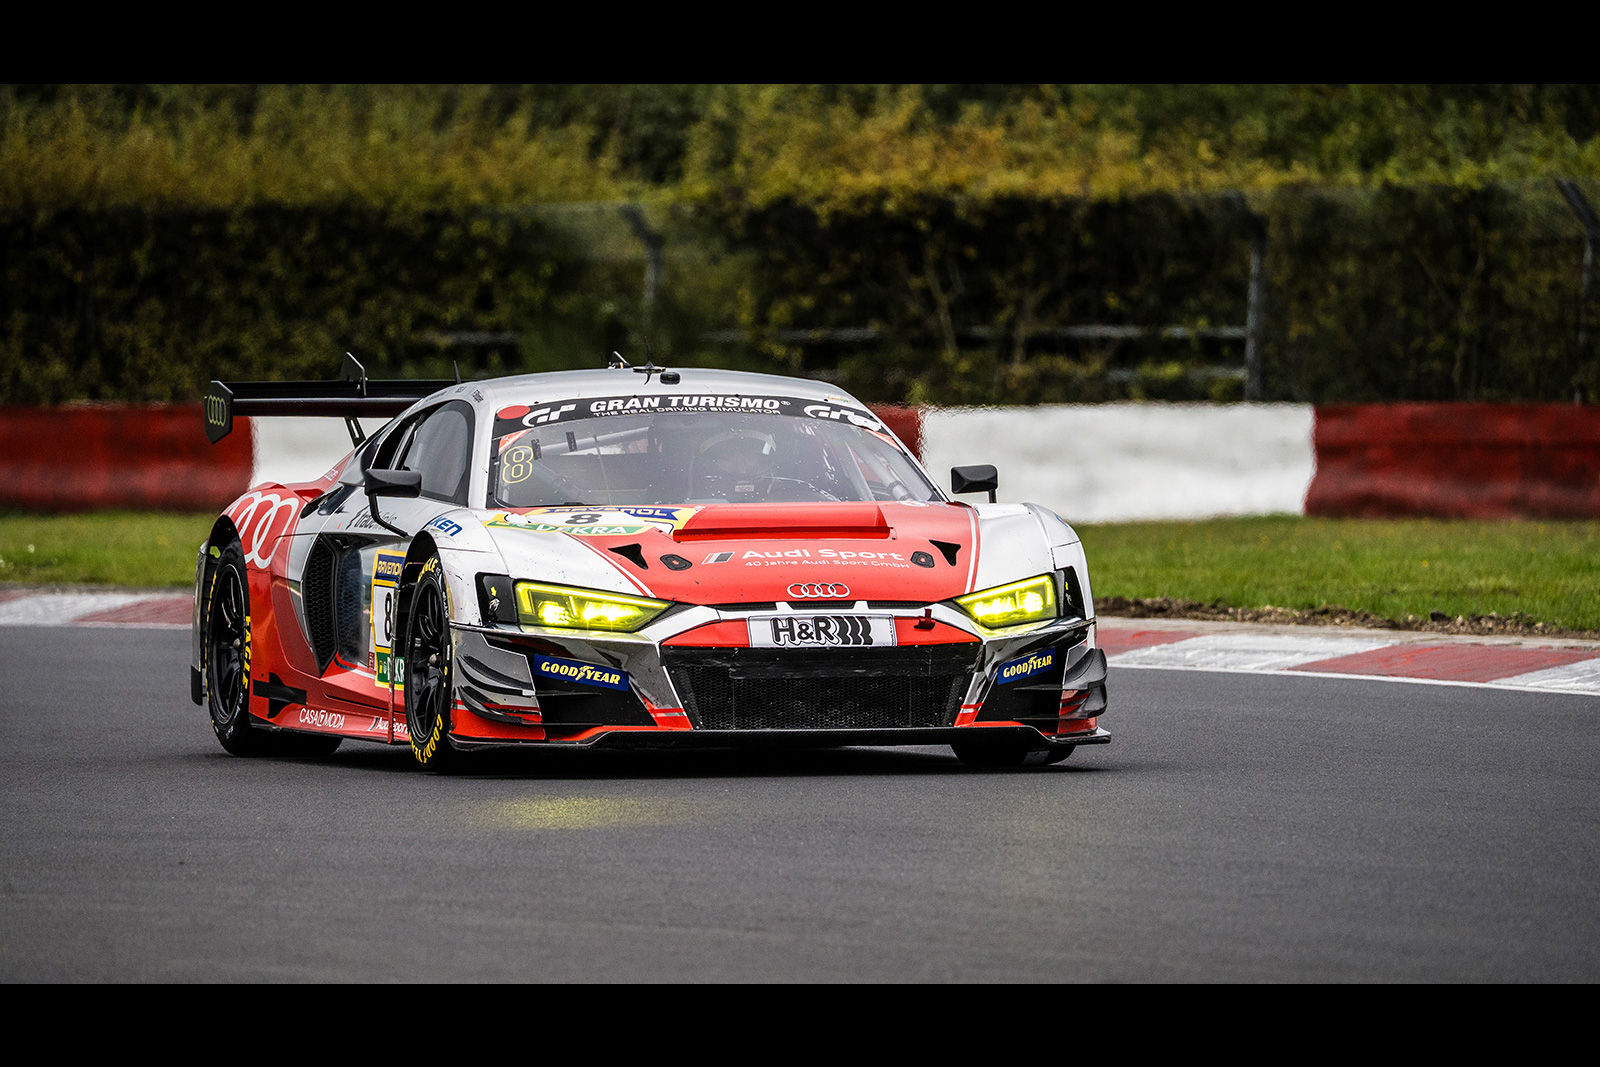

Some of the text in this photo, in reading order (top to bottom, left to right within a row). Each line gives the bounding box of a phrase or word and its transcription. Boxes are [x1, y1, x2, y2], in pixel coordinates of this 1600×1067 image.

[589, 396, 661, 413] GRAN
[710, 406, 781, 415] SIMULATOR
[502, 445, 534, 484] 8
[565, 513, 602, 524] 8
[742, 549, 904, 561] Audi Sport
[871, 561, 910, 569] GmbH
[384, 591, 393, 642] 8
[540, 660, 621, 686] GOODYEAR
[1003, 655, 1052, 678] GOODYEAR
